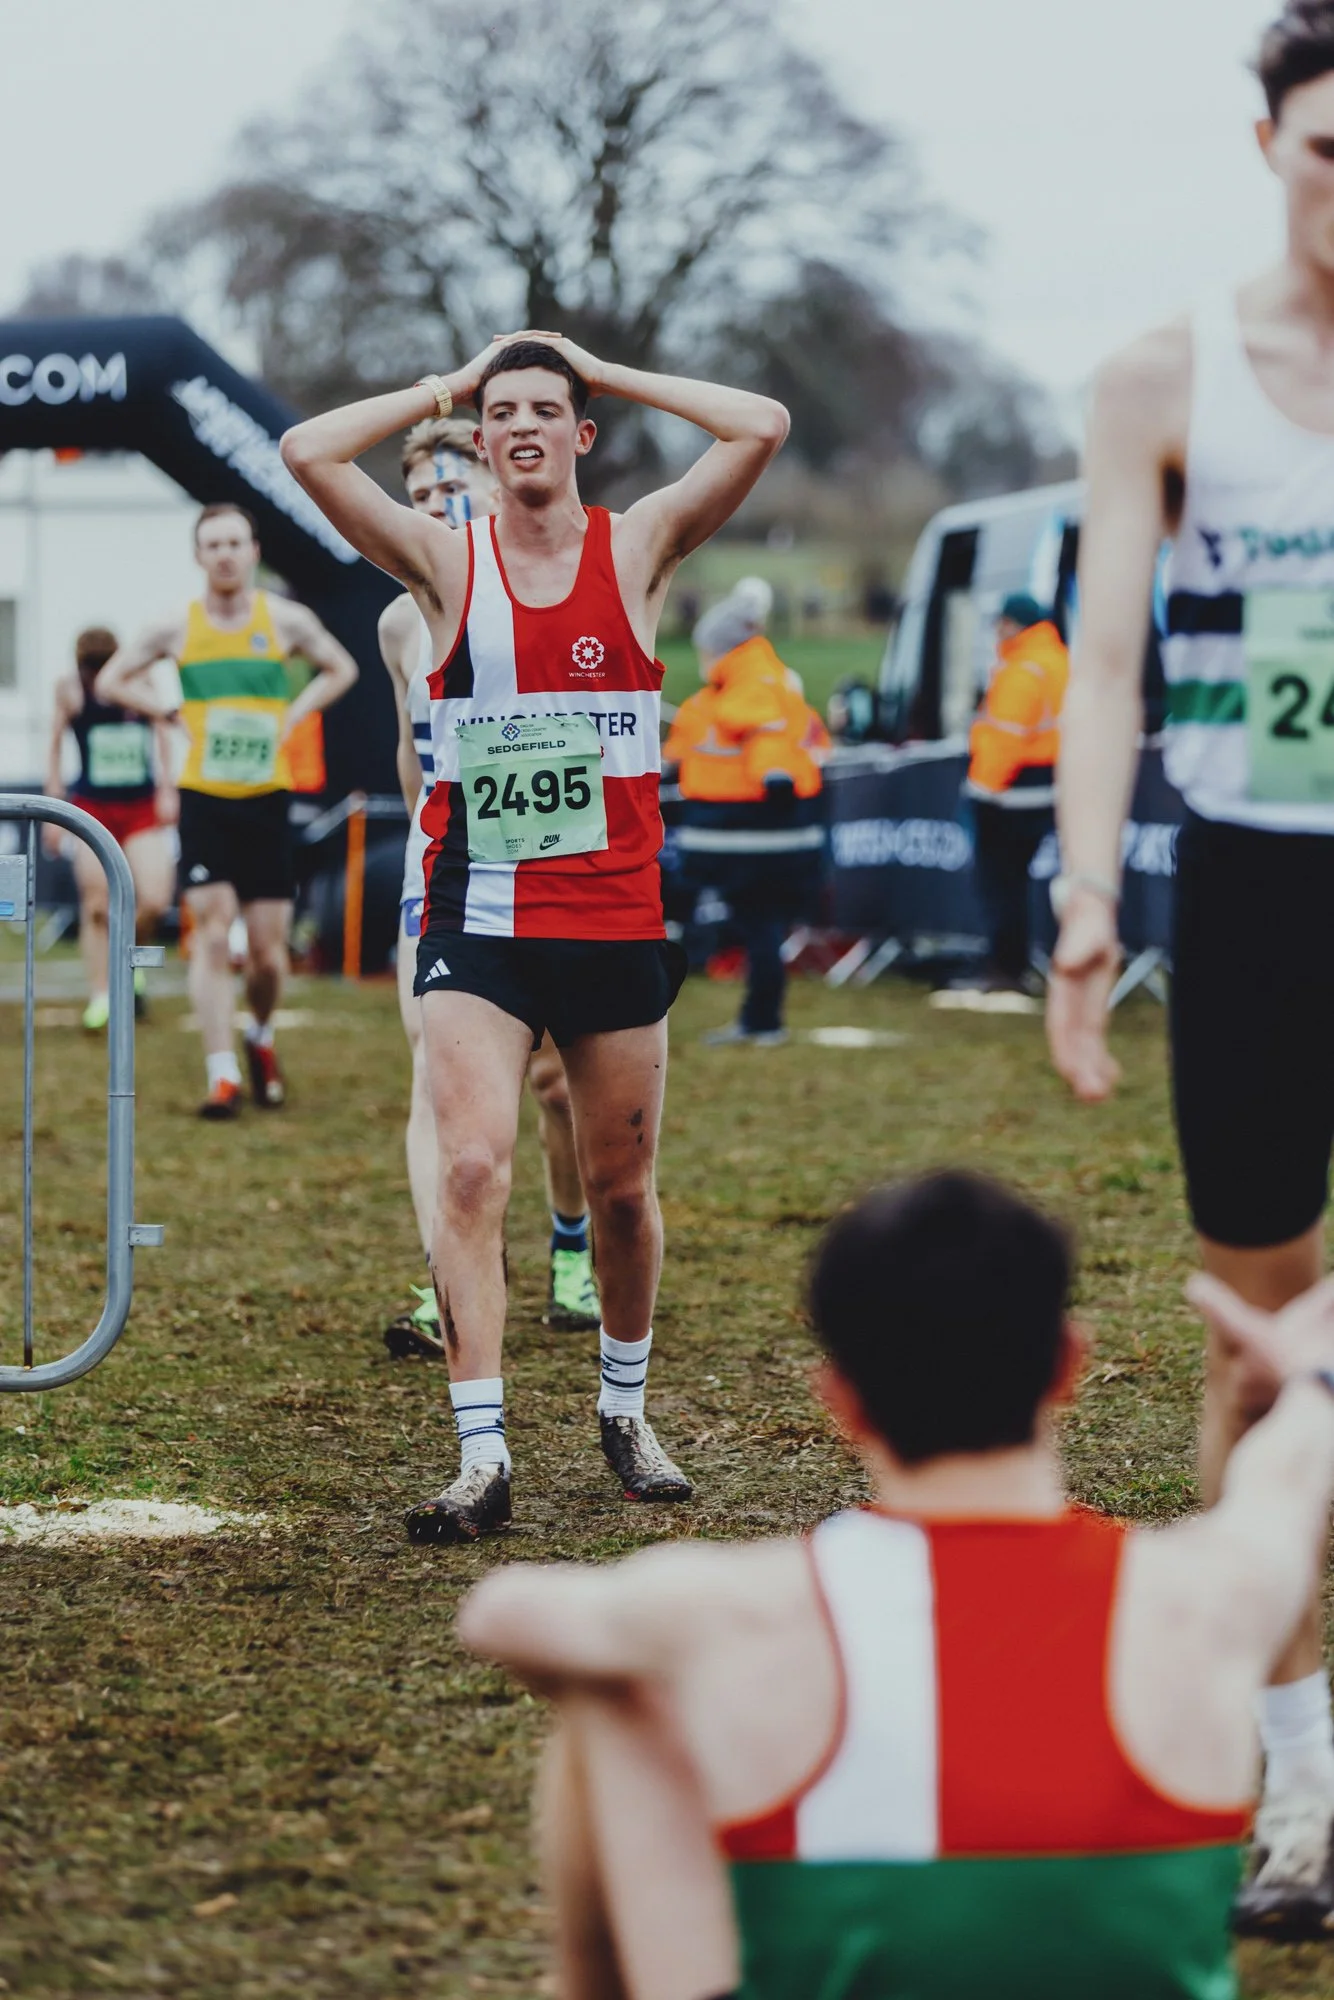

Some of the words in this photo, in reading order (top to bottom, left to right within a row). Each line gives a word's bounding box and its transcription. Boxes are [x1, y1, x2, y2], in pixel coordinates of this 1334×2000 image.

[0, 352, 127, 405] COM
[487, 739, 566, 755] SEDGEFIELD
[473, 766, 591, 820] 2495
[544, 834, 560, 843] RUN
